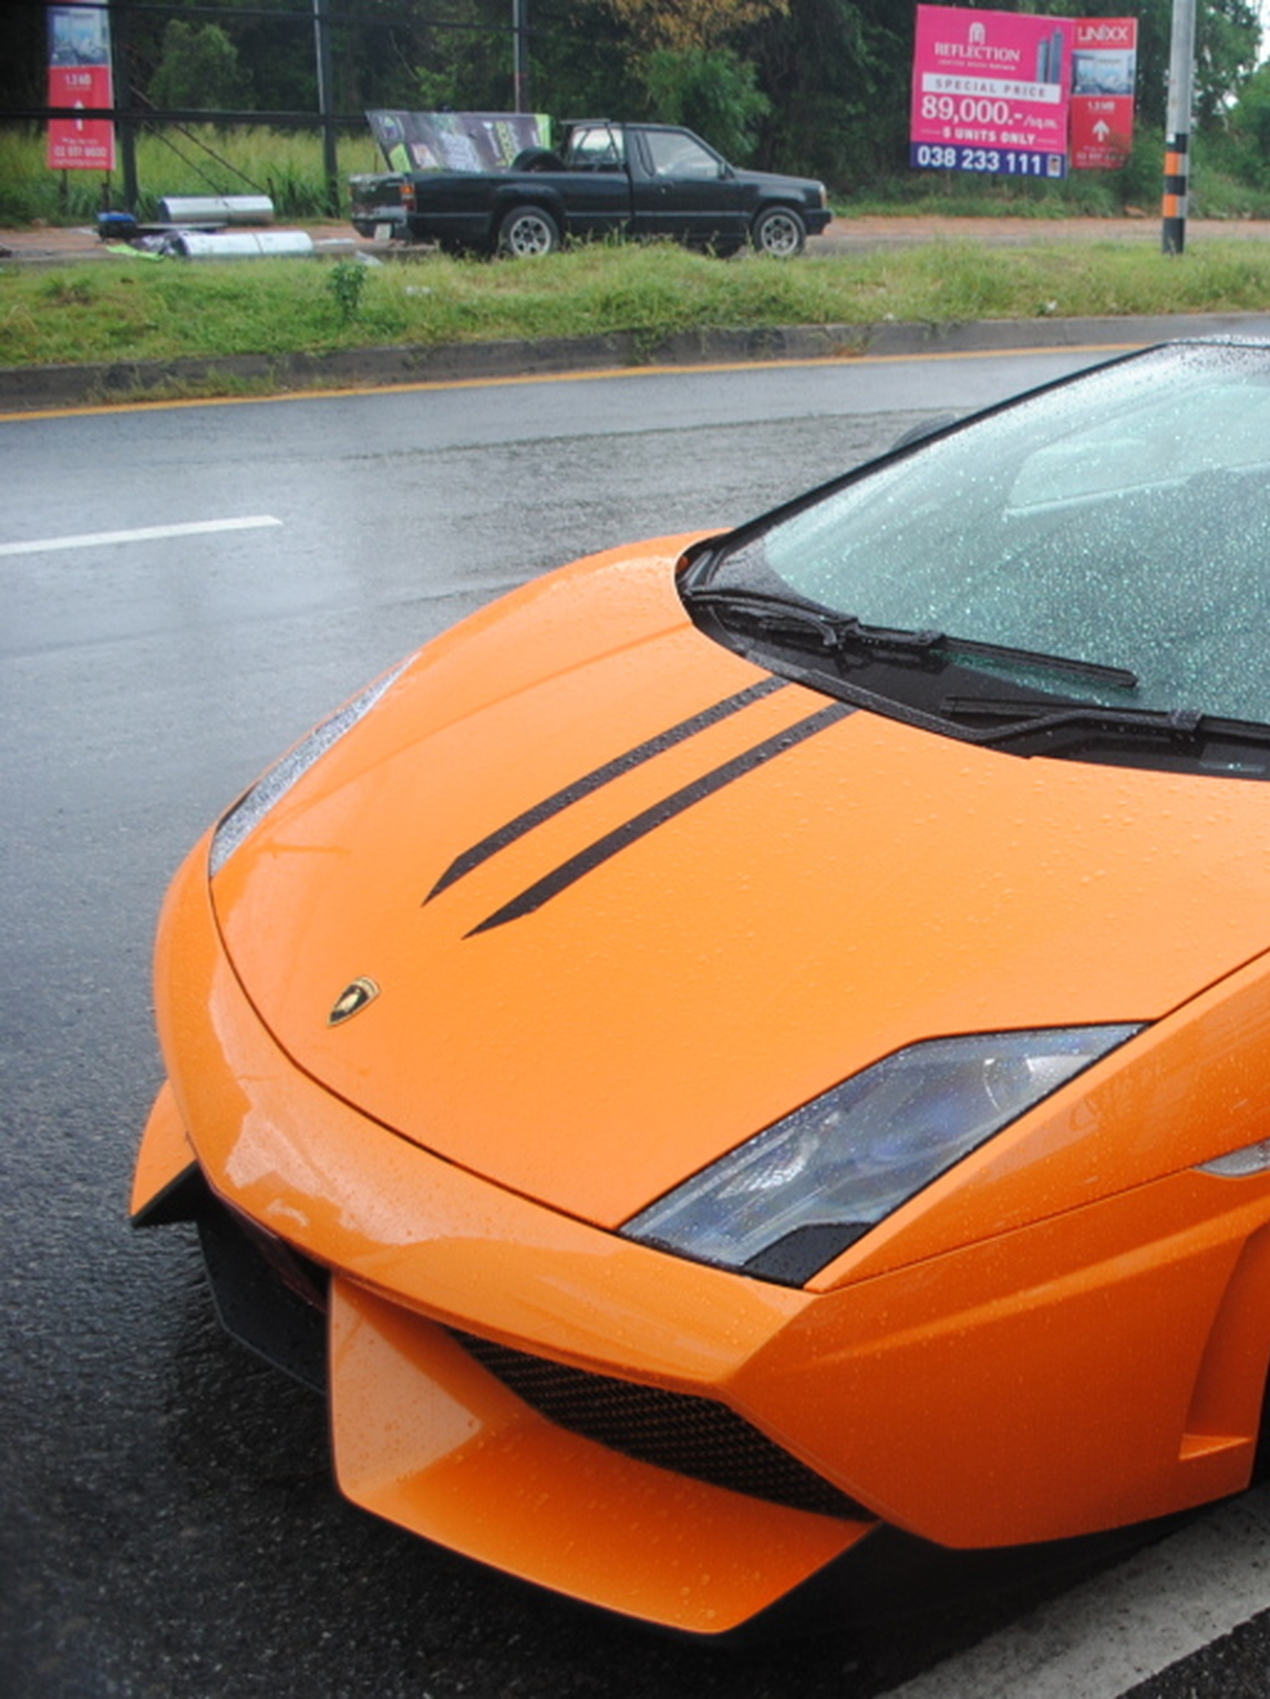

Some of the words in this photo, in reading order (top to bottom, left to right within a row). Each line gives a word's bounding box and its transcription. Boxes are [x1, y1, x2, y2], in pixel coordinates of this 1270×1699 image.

[934, 42, 1021, 62] REFLECTION
[935, 79, 998, 94] SPECIAL
[1004, 84, 1046, 98] PRICE
[955, 128, 998, 143] UNITS
[1001, 131, 1036, 145] ONLY
[917, 146, 957, 168] 038
[961, 149, 1000, 172] 233
[1006, 153, 1041, 175] 111
